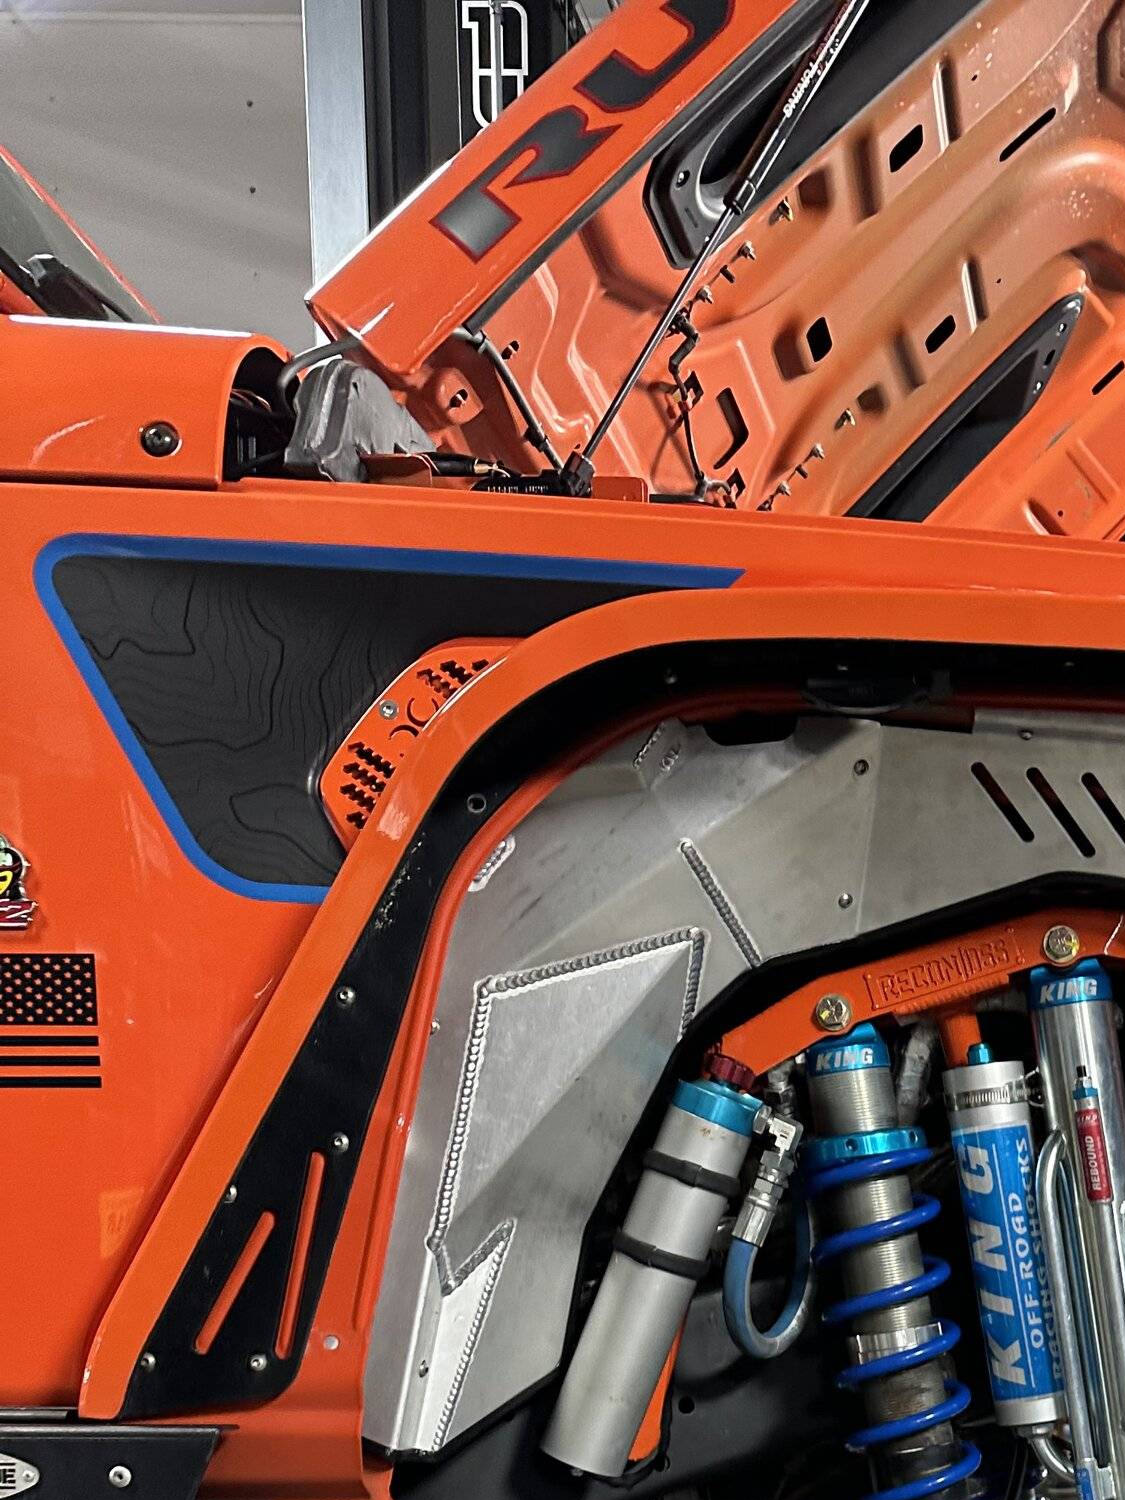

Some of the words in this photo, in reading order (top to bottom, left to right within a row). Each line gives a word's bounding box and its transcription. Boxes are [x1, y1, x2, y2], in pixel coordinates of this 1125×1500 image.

[1040, 977, 1098, 1004] KING
[815, 1047, 873, 1071] KING
[1084, 1135, 1102, 1191] REBOUND
[956, 1142, 1028, 1387] KING
[1008, 1191, 1045, 1350] OFF-ROAD
